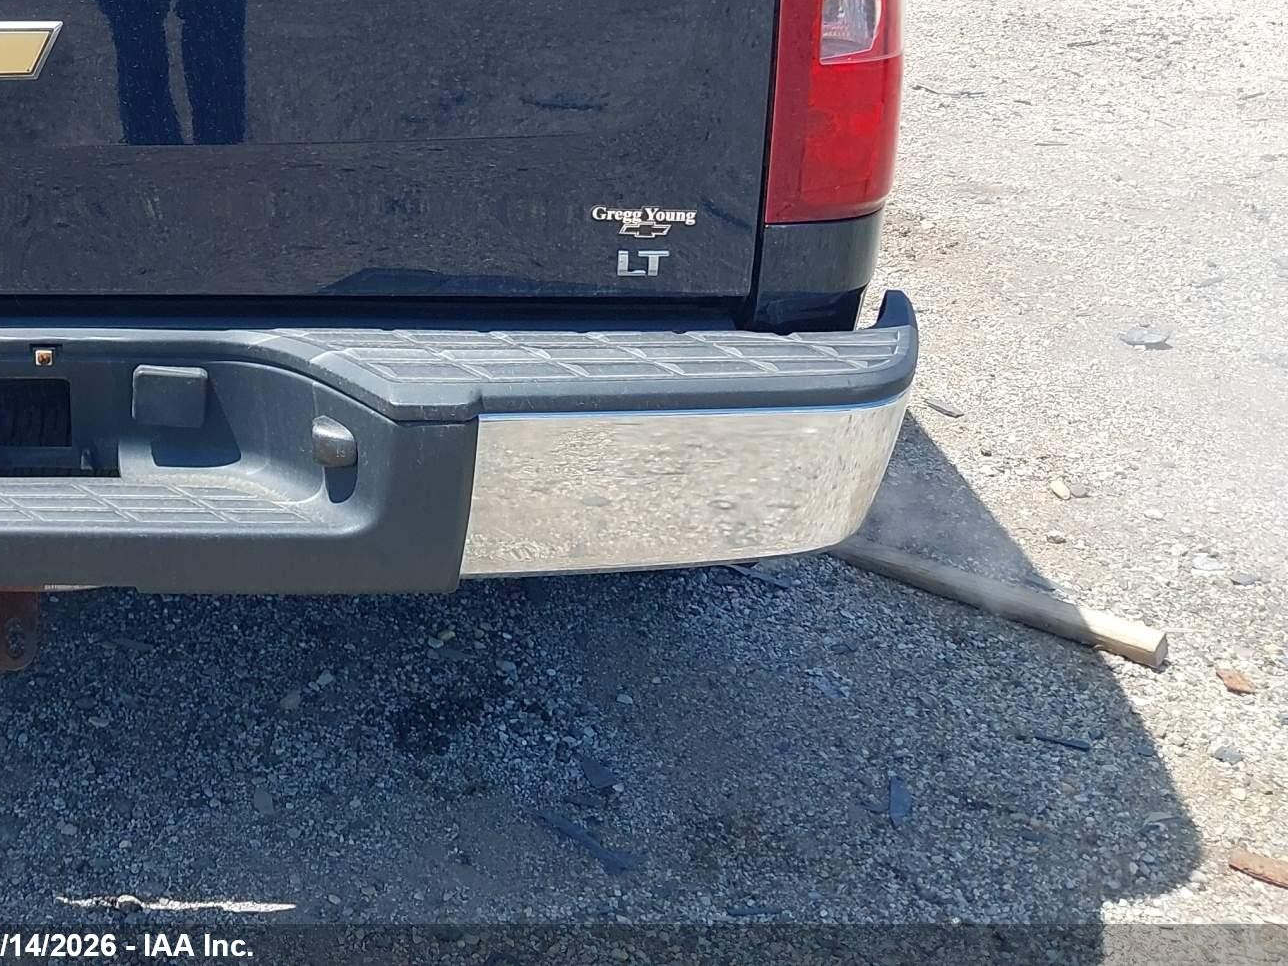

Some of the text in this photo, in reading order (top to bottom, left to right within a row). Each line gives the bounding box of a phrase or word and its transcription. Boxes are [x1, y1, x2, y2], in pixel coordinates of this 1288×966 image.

[591, 206, 697, 225] Gregg Young
[617, 250, 670, 277] LT
